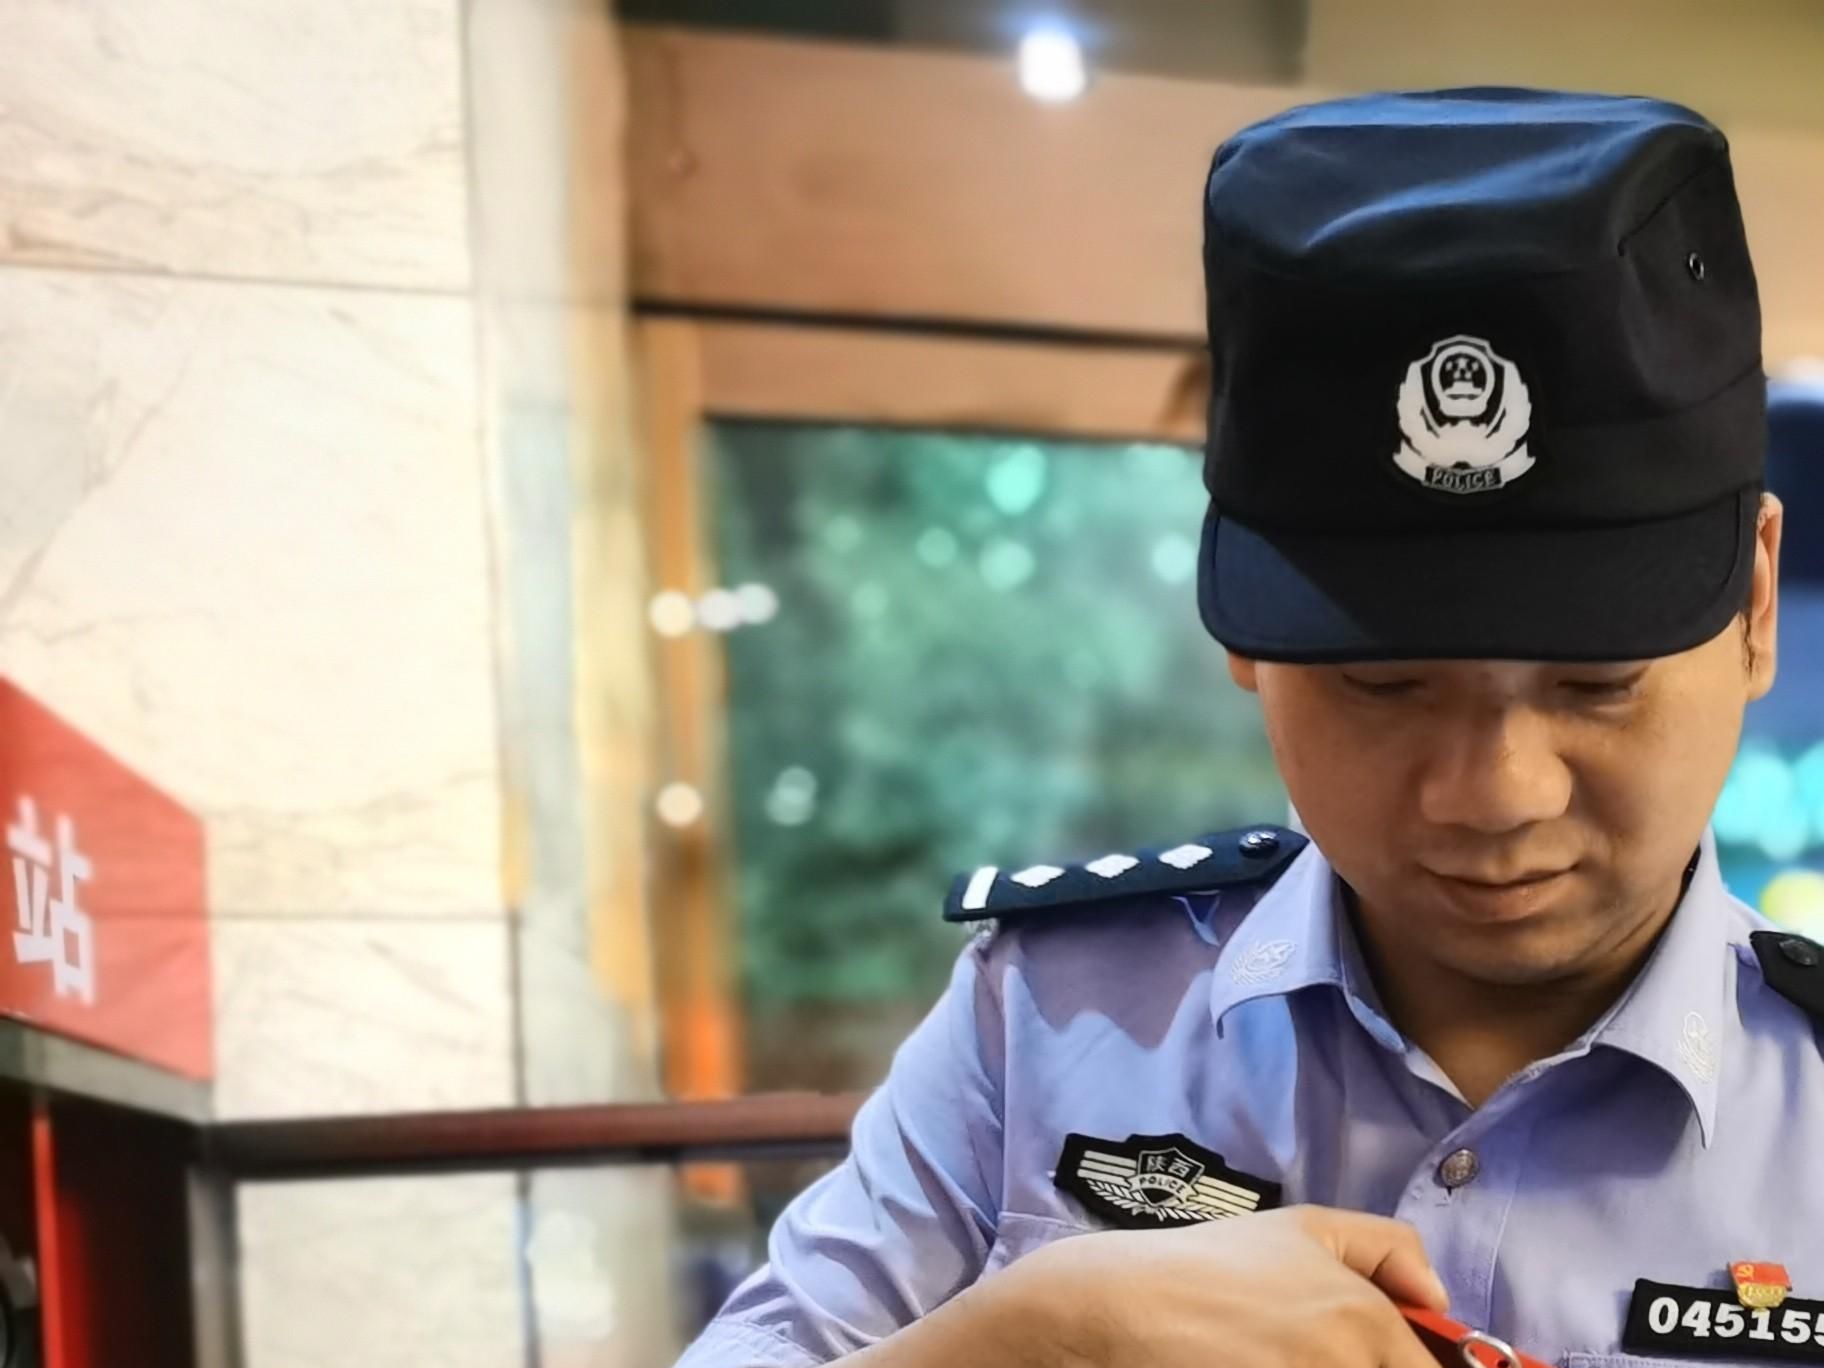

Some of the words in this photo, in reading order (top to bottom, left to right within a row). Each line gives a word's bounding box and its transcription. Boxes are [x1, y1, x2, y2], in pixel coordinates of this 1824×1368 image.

[1431, 468, 1496, 491] POLICE
[6, 794, 94, 1008] 站
[1146, 1154, 1194, 1179] 陕西
[1139, 1175, 1185, 1195] POLICE
